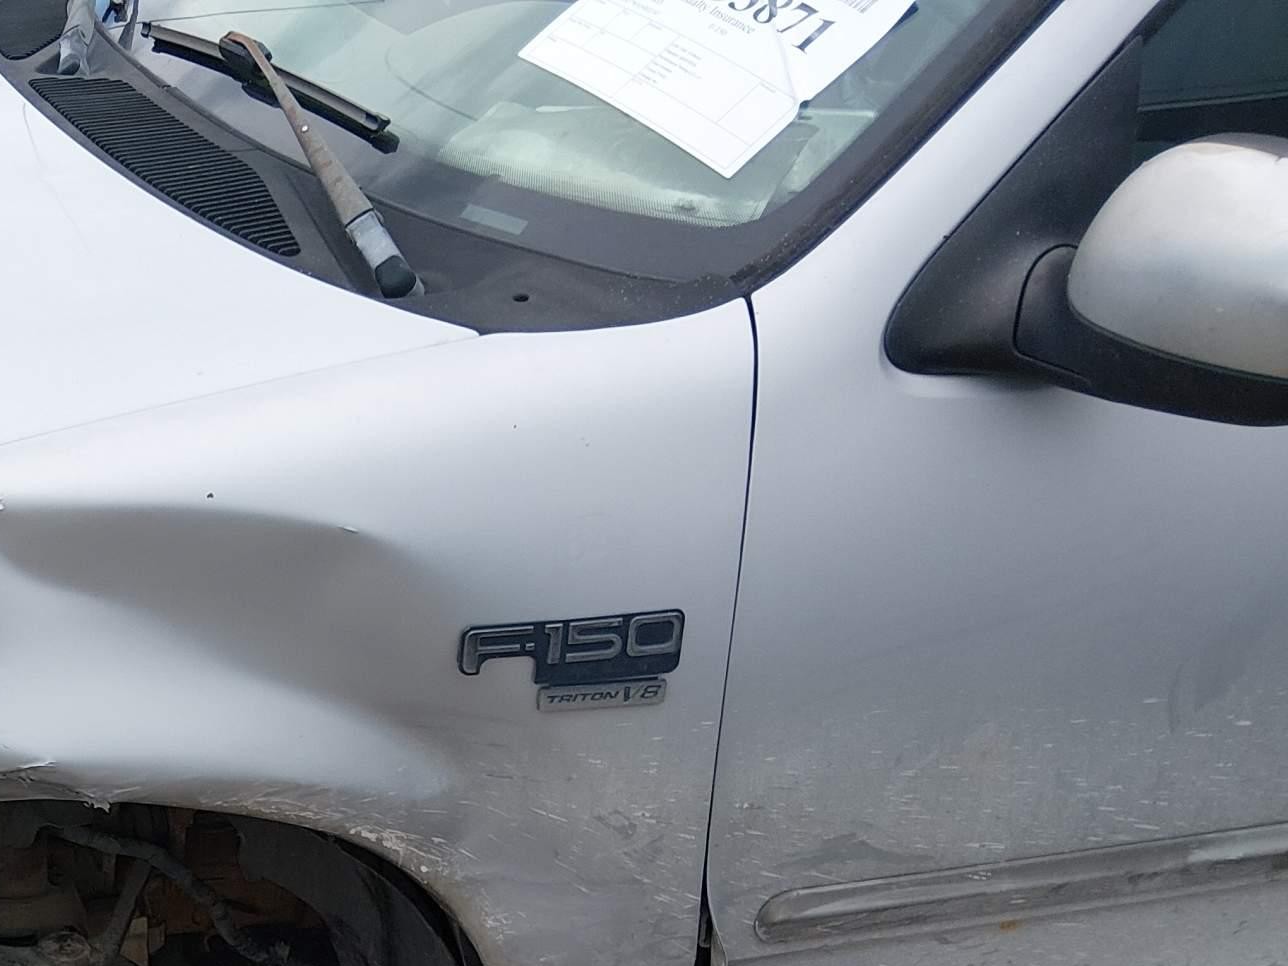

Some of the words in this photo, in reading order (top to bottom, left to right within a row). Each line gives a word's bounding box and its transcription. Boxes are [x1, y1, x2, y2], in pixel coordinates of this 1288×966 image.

[462, 611, 683, 673] F-150
[546, 690, 620, 704] TRITON
[622, 685, 662, 703] V8
